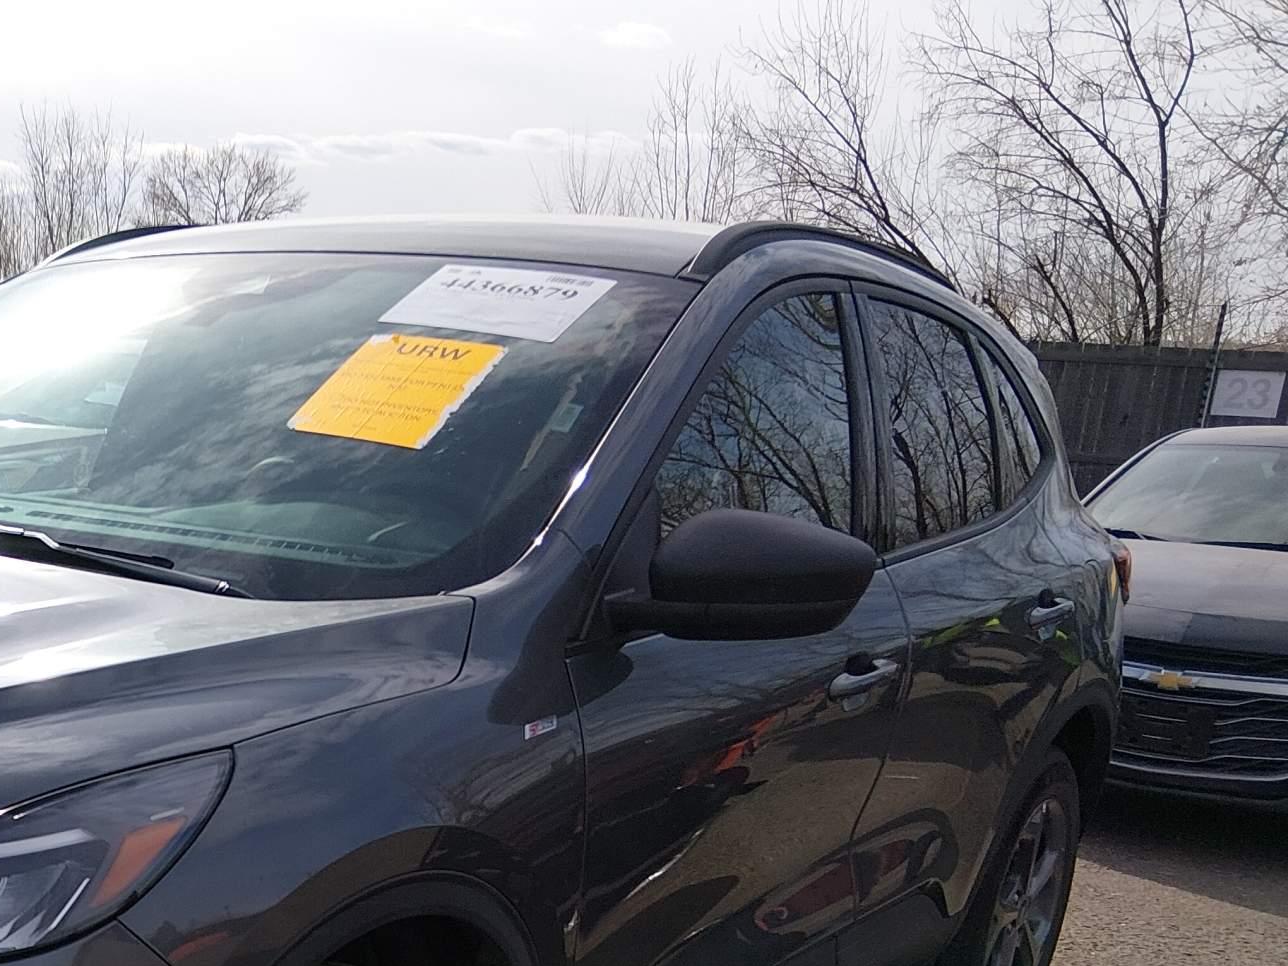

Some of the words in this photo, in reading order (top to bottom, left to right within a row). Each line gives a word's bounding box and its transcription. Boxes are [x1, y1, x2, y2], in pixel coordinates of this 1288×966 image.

[440, 277, 580, 301] 44366879
[396, 342, 473, 361] URW
[1226, 376, 1273, 411] 23
